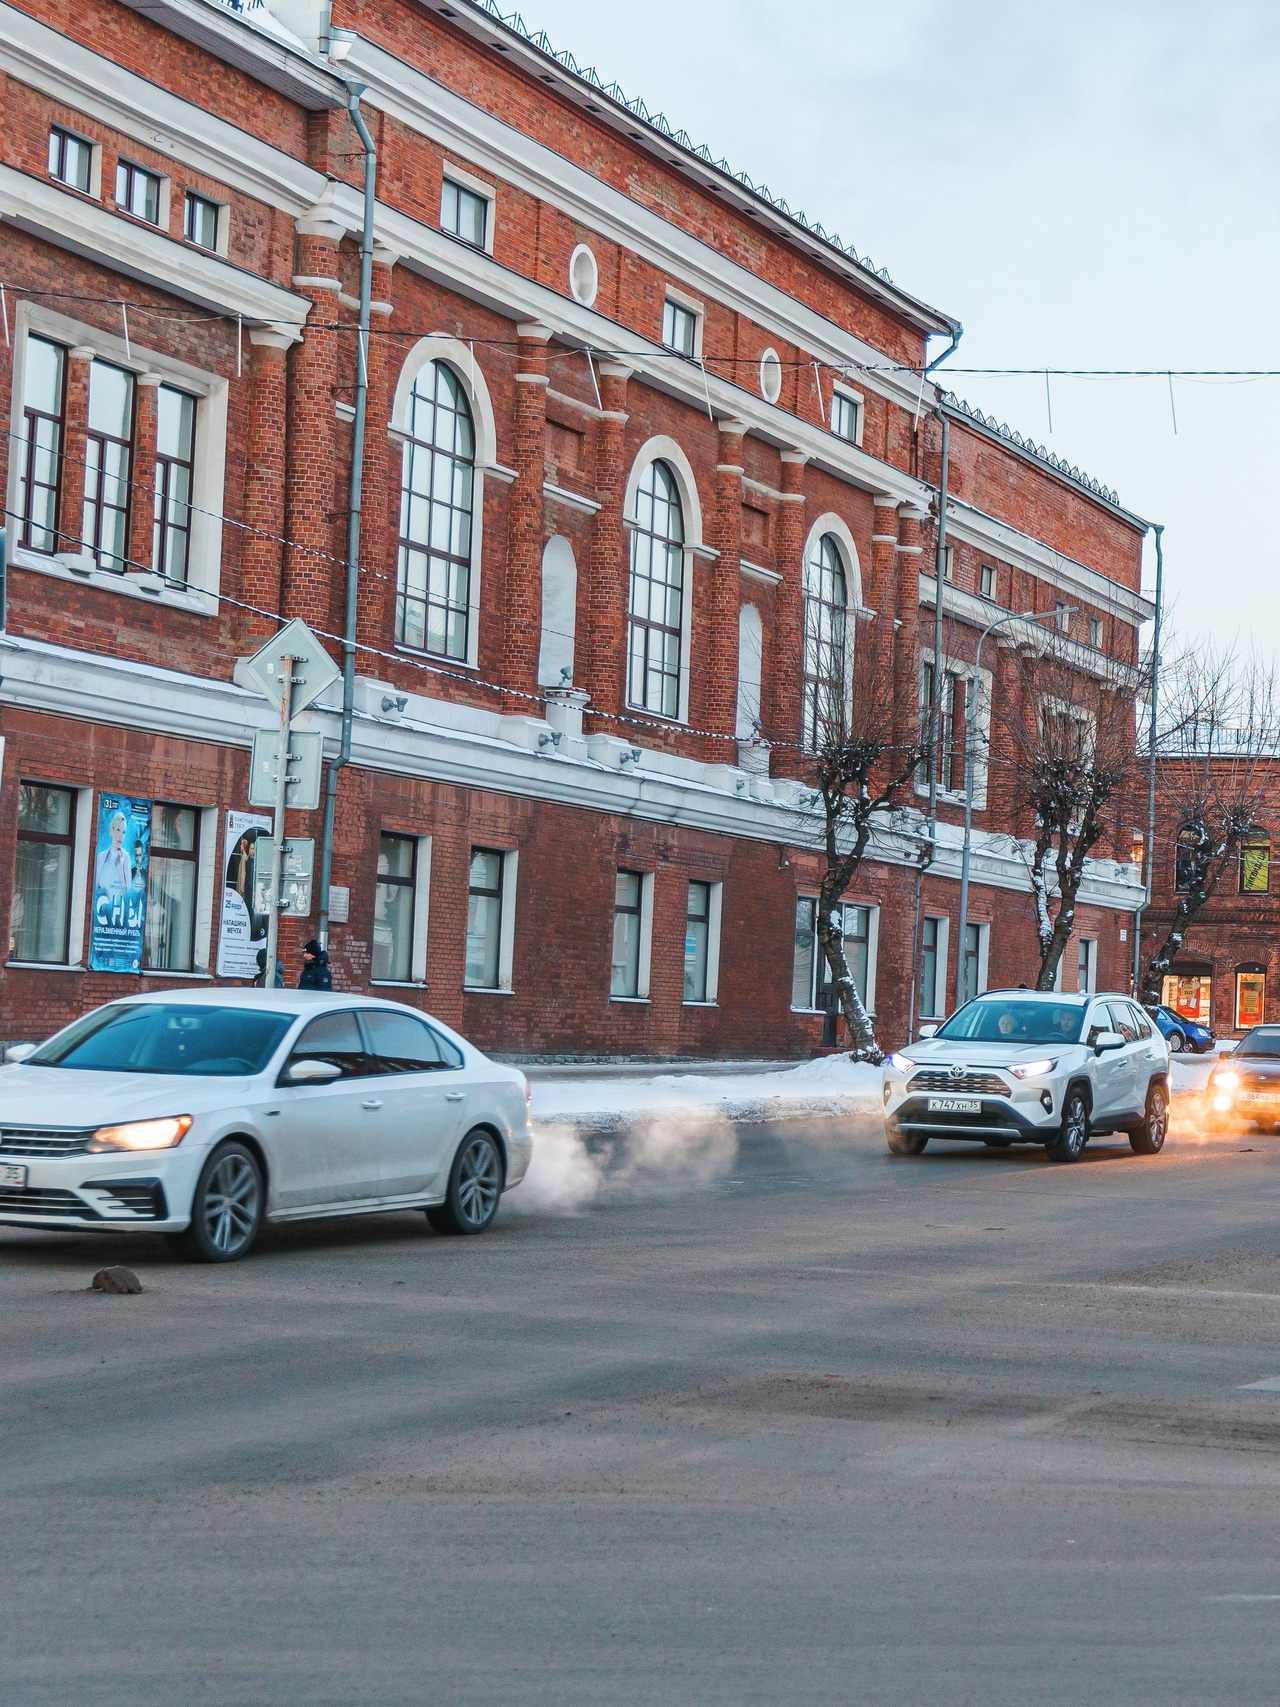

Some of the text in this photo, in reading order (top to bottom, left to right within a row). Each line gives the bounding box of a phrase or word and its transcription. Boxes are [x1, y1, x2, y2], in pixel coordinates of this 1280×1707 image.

[104, 799, 112, 808] 31
[225, 900, 232, 909] 25
[96, 894, 143, 928] СНЫ
[223, 919, 247, 928] НАТАШИНА
[94, 926, 141, 937] НЕРАЗМЕННЫЙ РУБЛЬ
[227, 927, 242, 935] МЕЧТА
[932, 1100, 978, 1110] К747ХН 35
